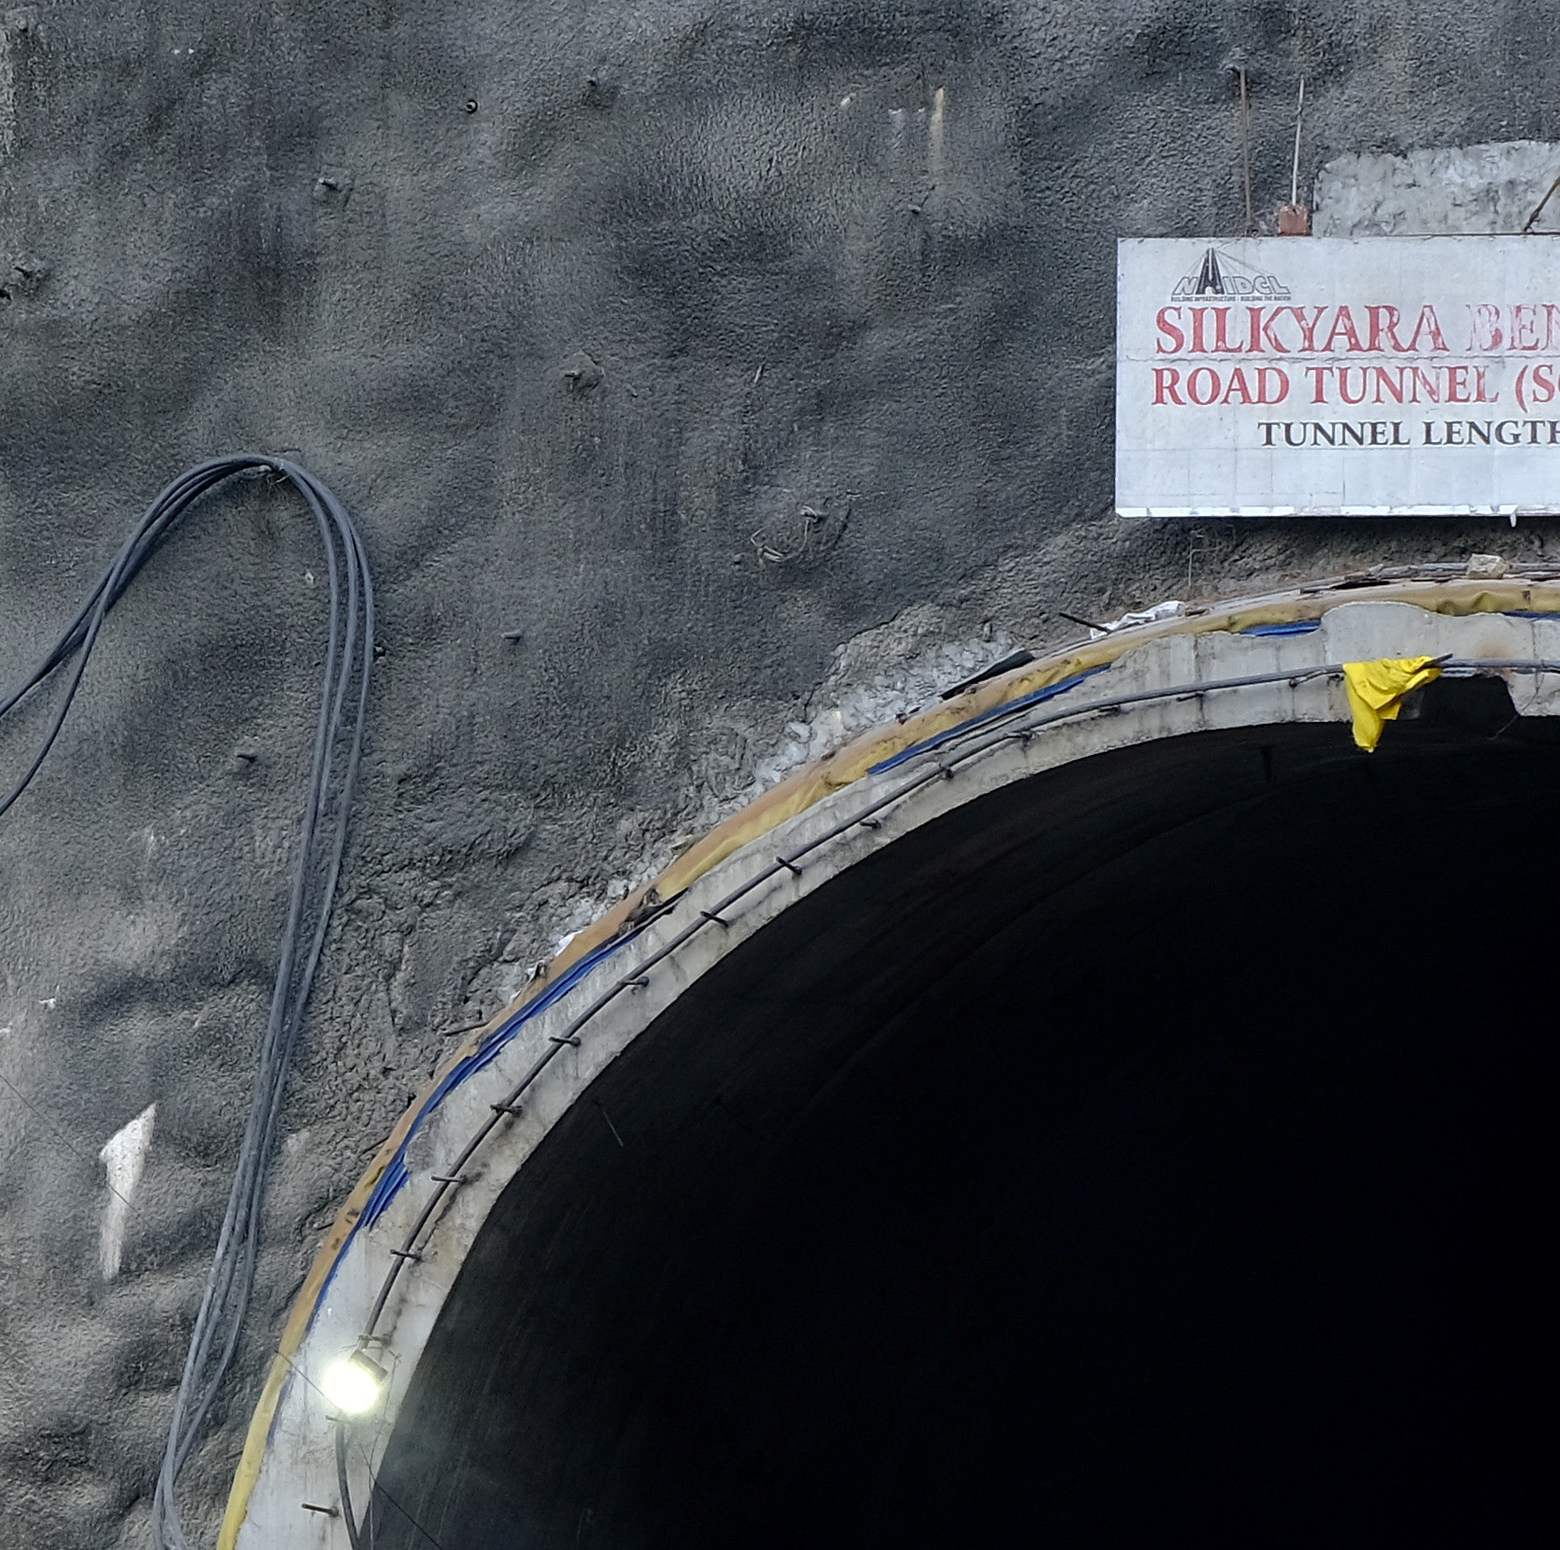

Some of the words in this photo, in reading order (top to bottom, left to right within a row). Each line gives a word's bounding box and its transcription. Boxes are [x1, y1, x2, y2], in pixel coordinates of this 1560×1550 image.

[1155, 304, 1451, 354] SILKYARA
[1151, 366, 1290, 405] ROAD
[1304, 363, 1500, 405] TUNNEL
[1257, 420, 1410, 447] TUNNEL
